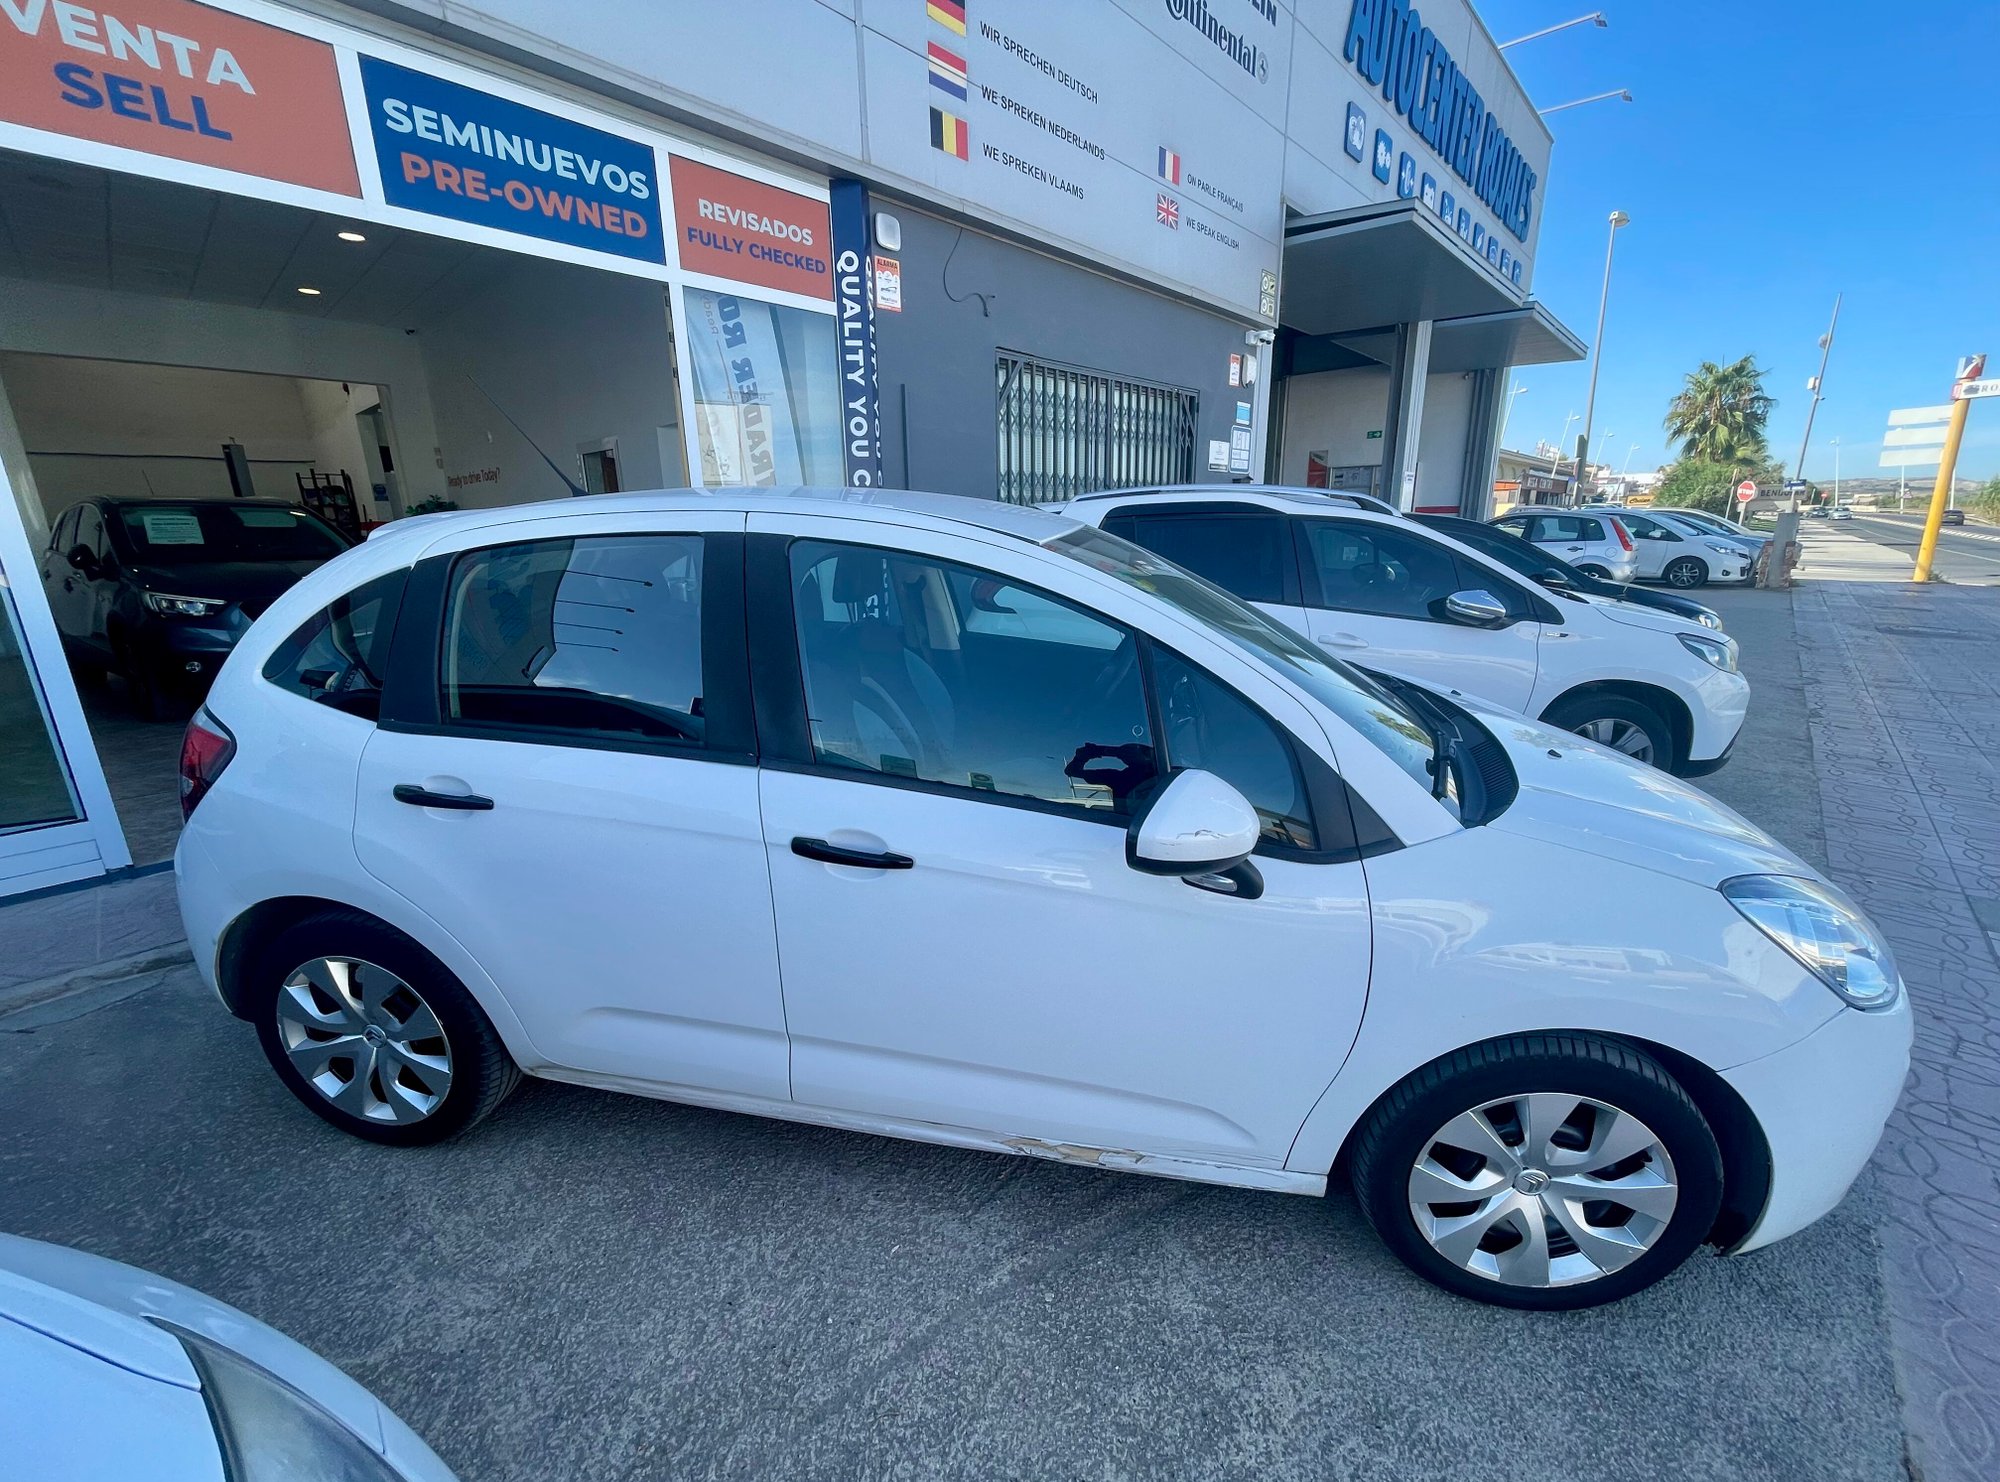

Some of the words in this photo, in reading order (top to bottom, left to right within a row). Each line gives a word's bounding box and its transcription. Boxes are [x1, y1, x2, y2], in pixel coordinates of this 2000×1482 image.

[0, 0, 256, 95] VENTA
[980, 21, 1001, 46] WIR
[1003, 36, 1055, 79] SPRECHEN
[1057, 69, 1098, 104] DEUTSCH
[54, 62, 232, 141] SELL
[981, 84, 998, 105] WE
[1000, 95, 1046, 130] SPREKEN
[1048, 120, 1106, 161] NEDERLANDS
[1343, 0, 1485, 188] AUTOCENTER
[1475, 111, 1537, 243] ROJALES
[382, 98, 650, 199] SEMINUEVOS
[983, 142, 999, 162] WE
[1002, 152, 1047, 183] SPREKEN
[1049, 173, 1084, 200] VLAAMS
[400, 152, 647, 239] PRE-OWNED
[698, 199, 814, 246] REVISADOS
[1187, 173, 1197, 187] ON
[1197, 179, 1216, 198] PARLE
[1217, 190, 1244, 212] FRANÇAIS
[687, 227, 744, 254] FULLY
[749, 243, 826, 274] CHECKED
[1186, 216, 1196, 230] WE
[1196, 221, 1216, 239] SPEAK
[1216, 231, 1240, 250] ENGLISH
[837, 250, 866, 387] QUALITY
[848, 396, 869, 457] YOU
